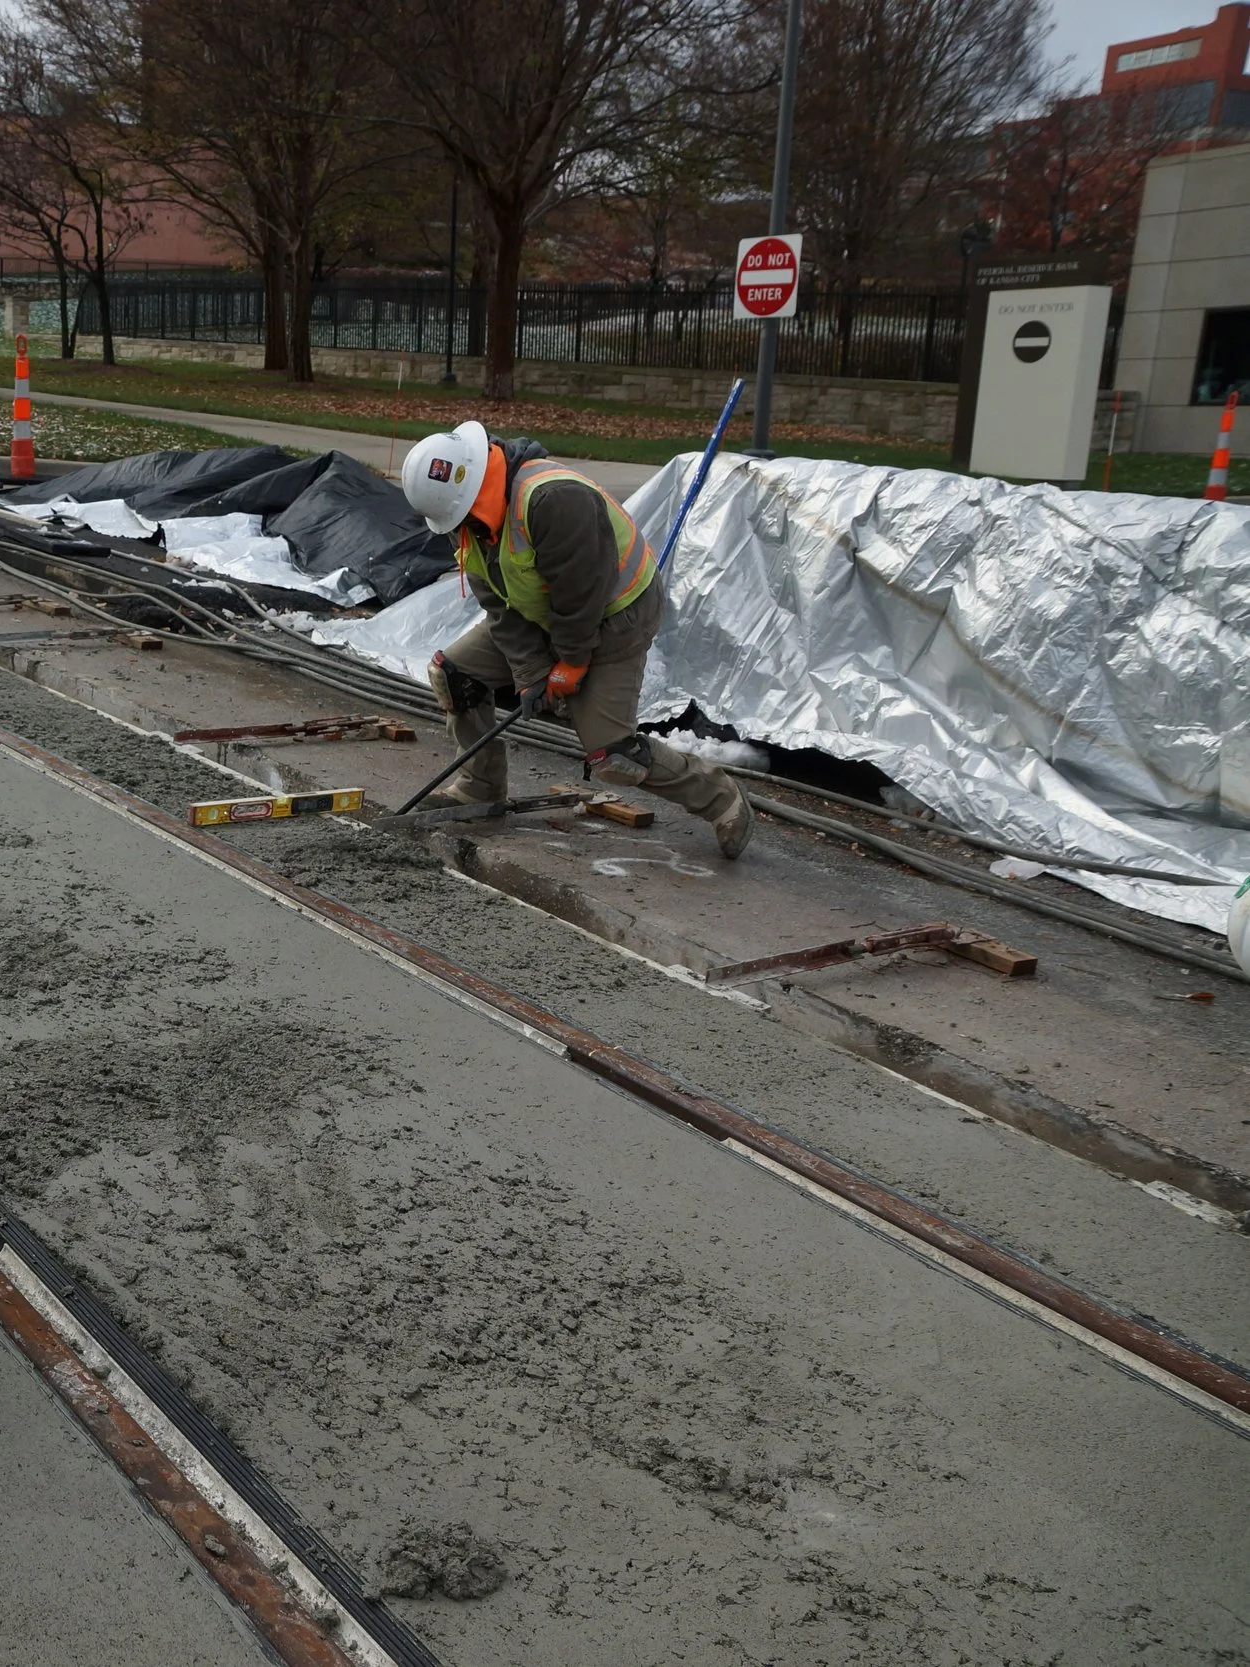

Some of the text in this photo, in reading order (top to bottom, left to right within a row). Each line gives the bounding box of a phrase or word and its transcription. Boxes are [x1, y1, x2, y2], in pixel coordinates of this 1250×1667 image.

[747, 252, 791, 268] DO NOT
[747, 287, 783, 301] ENTER
[998, 302, 1075, 315] DO NOT ENTER
